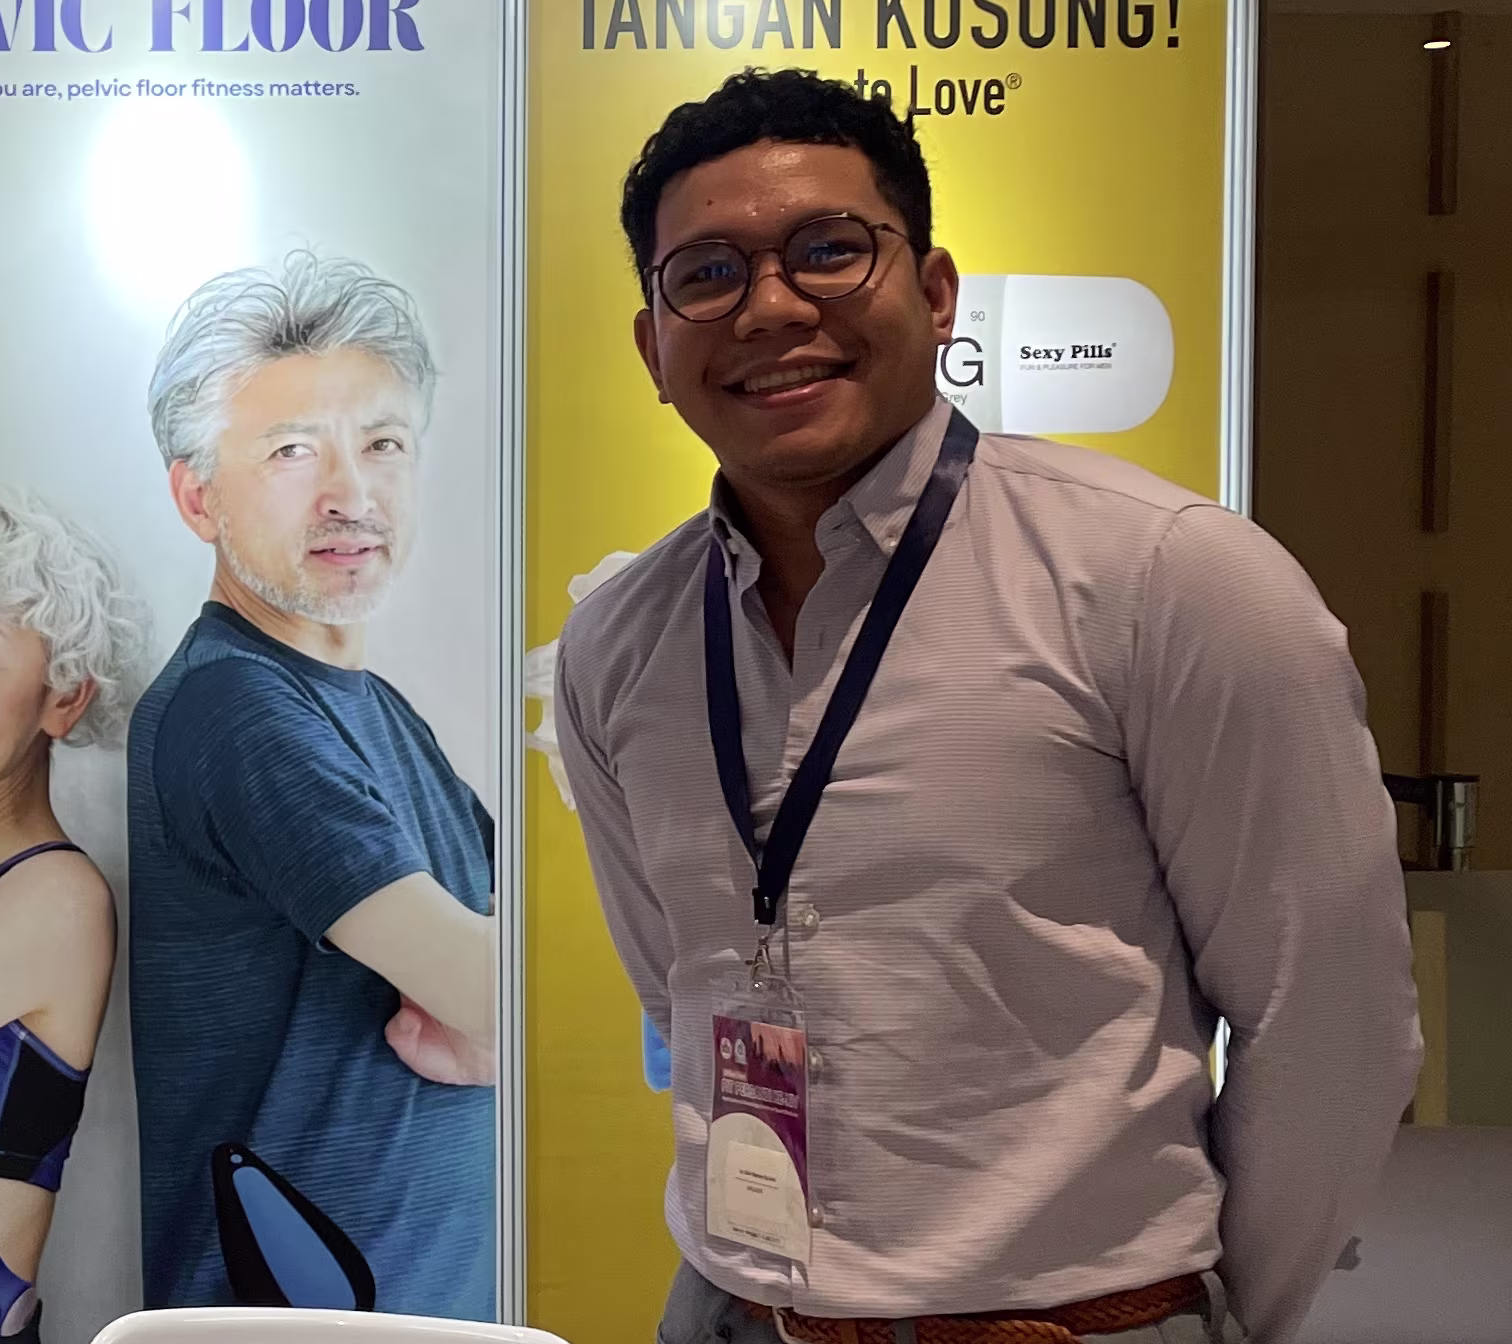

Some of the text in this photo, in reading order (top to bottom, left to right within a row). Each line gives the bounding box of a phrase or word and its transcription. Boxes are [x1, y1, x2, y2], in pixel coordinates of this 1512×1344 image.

[21, 84, 63, 100] are,
[67, 77, 131, 102] pelvic
[135, 78, 188, 97] floor
[192, 77, 265, 97] fitness
[269, 80, 360, 97] matters.
[1020, 345, 1065, 362] Sexy
